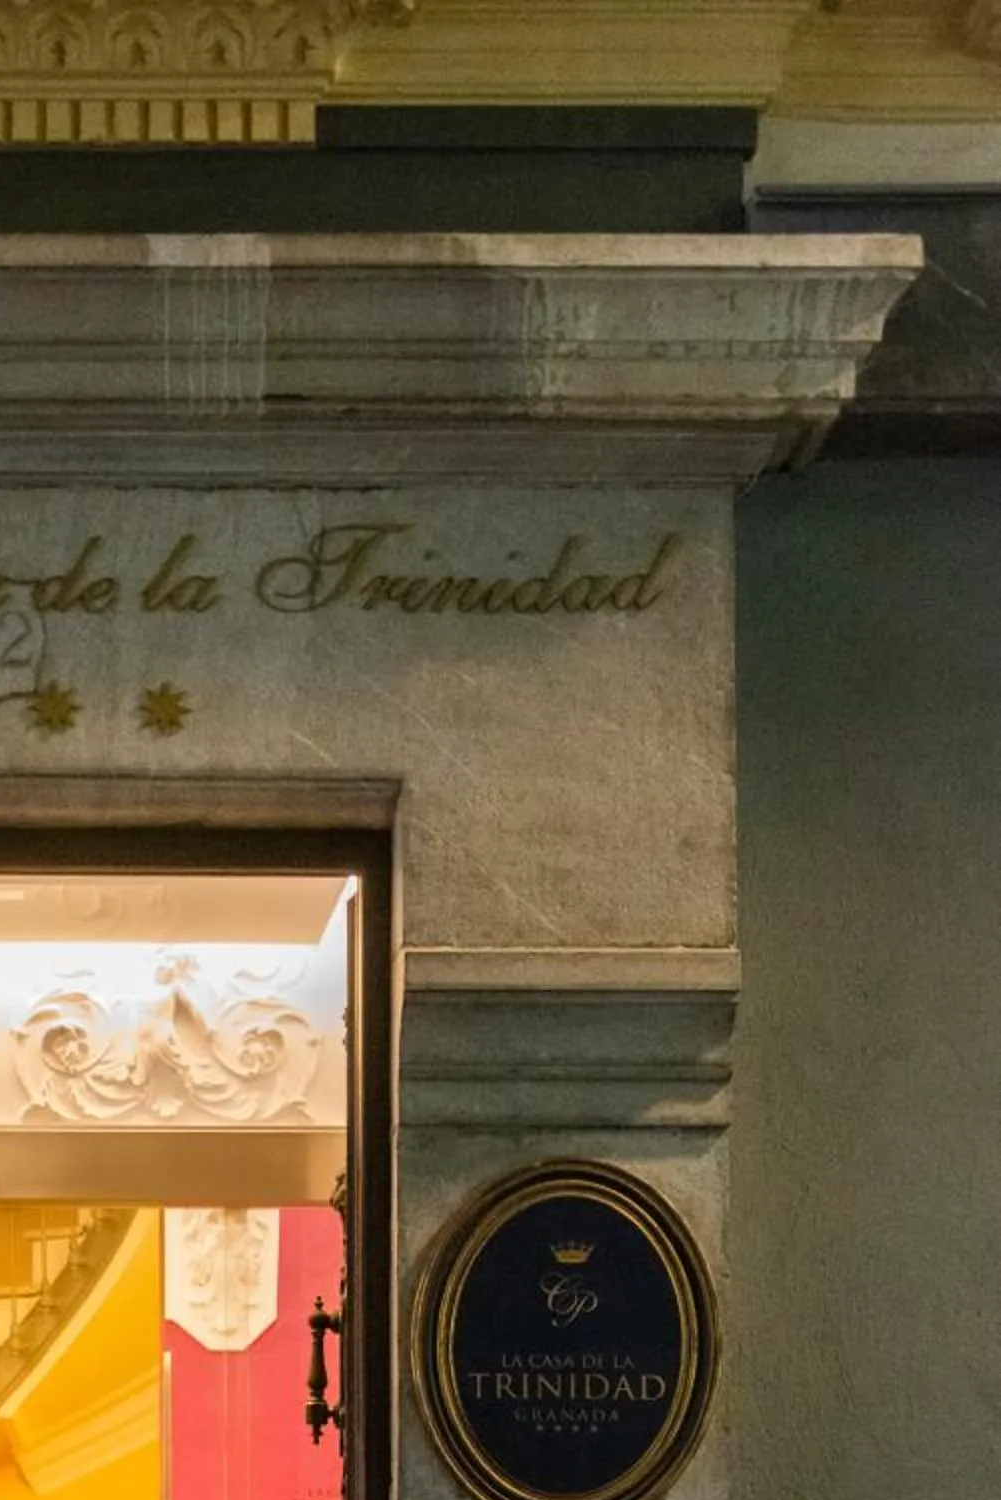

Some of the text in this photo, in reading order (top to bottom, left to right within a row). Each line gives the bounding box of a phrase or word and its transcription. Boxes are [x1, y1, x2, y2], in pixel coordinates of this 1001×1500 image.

[29, 535, 120, 614] de
[141, 533, 225, 614] la
[255, 523, 684, 614] Trinidad
[501, 1353, 635, 1370] LA CASA DE LA
[468, 1371, 667, 1401] TRINIDAD
[513, 1407, 620, 1423] GRANADA
